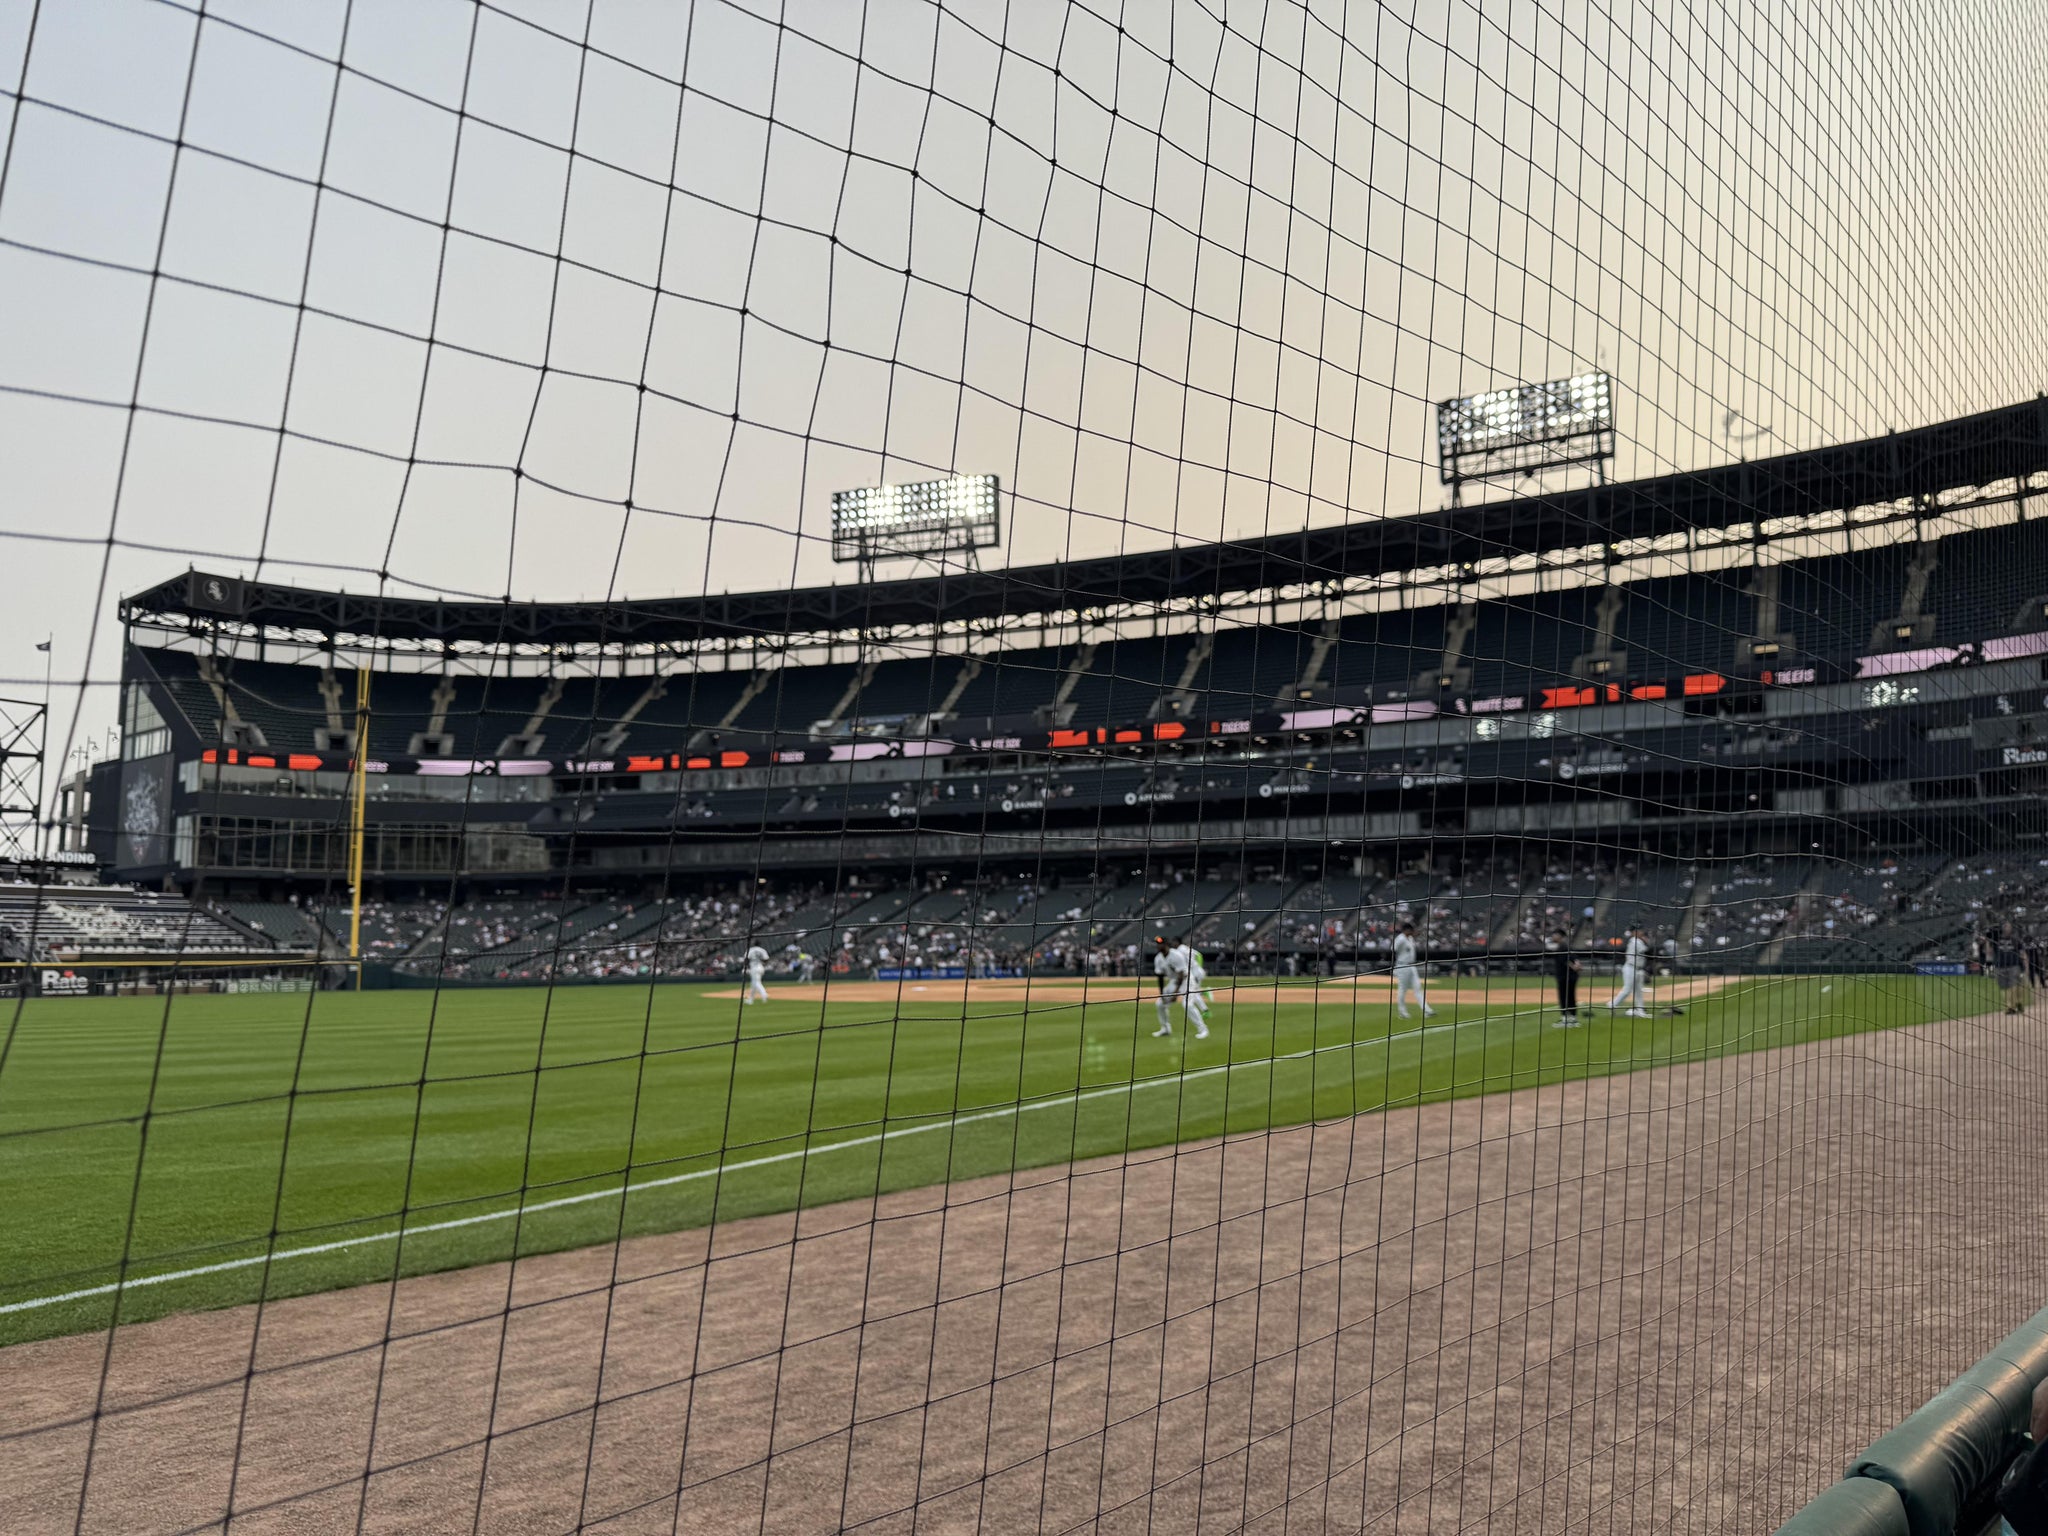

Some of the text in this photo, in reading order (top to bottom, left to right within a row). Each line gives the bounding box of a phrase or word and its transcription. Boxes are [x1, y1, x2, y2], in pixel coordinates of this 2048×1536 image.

[1472, 699, 1502, 713] WHITE
[1503, 697, 1524, 710] SOX
[41, 969, 88, 989] Rate
